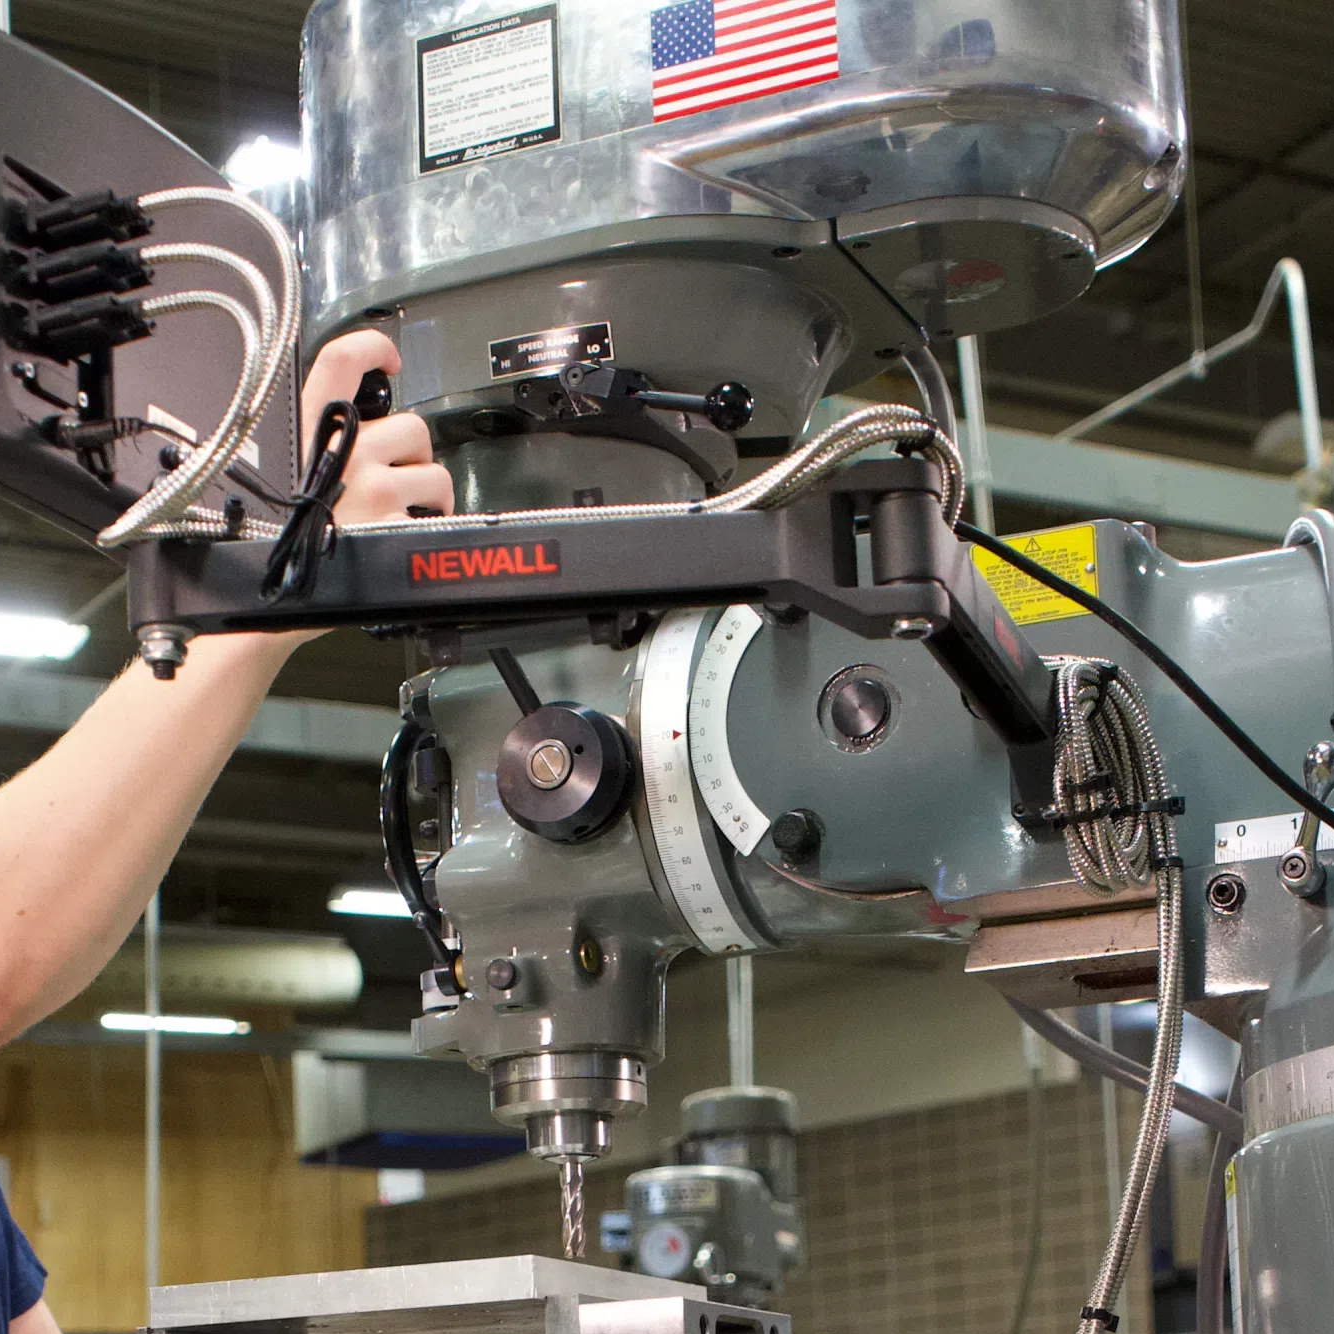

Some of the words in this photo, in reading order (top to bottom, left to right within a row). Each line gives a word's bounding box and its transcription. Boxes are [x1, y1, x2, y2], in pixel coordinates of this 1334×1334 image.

[451, 23, 501, 42] LUBRICATION
[501, 16, 521, 29] DATA
[517, 340, 544, 353] SPEED
[546, 333, 580, 347] RANGE
[500, 359, 512, 369] HI
[527, 348, 569, 363] NEUTRAL
[586, 343, 601, 354] LO
[411, 543, 558, 581] NEWALL
[730, 619, 743, 630] 40
[716, 644, 727, 655] 30
[706, 671, 717, 681] 20
[700, 699, 710, 708] 10
[699, 727, 706, 737] 0
[702, 754, 713, 764] 10
[663, 762, 673, 772] 30
[711, 778, 722, 790] 20
[667, 794, 678, 803] 40
[722, 802, 734, 814] 30
[673, 826, 684, 836] 50
[738, 821, 750, 833] 40
[1236, 824, 1246, 837] 0
[681, 856, 692, 865] 60
[691, 883, 702, 892] 70
[702, 906, 713, 914] 80
